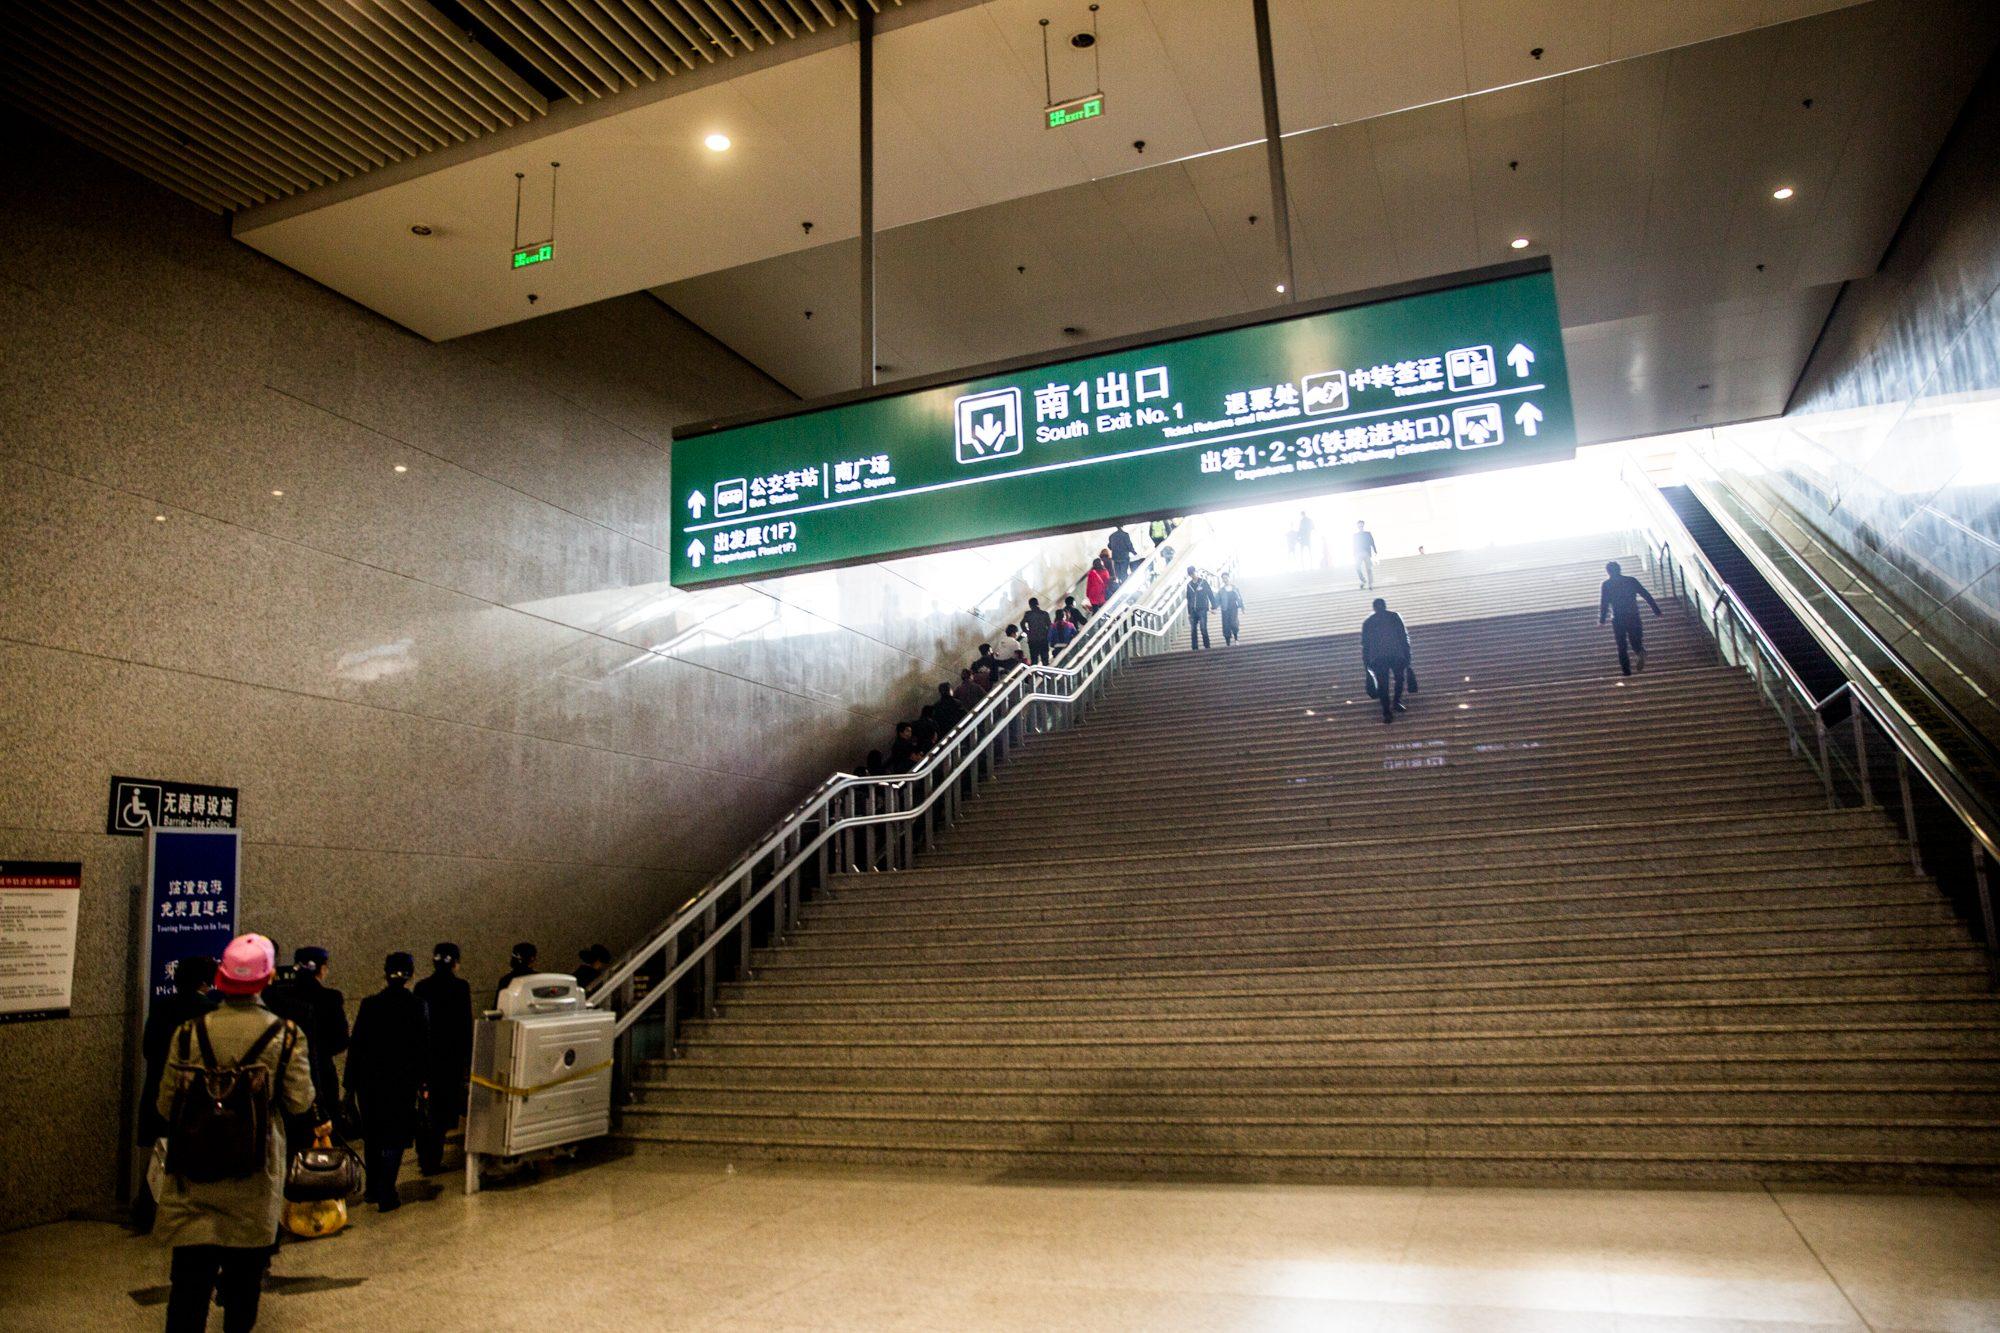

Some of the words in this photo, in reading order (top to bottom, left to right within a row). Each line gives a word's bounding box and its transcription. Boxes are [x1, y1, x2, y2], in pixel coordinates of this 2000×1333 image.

[1348, 357, 1444, 392] 中转签证
[1391, 380, 1445, 397] Transfer
[1034, 365, 1169, 422] 南1出口
[1036, 420, 1089, 443] South
[1096, 412, 1133, 433] Exit
[749, 466, 819, 497] 公交车站
[834, 454, 890, 482] 南广场
[834, 481, 862, 494] South
[863, 475, 897, 489] Square
[749, 498, 767, 509] Bus
[767, 492, 799, 505] Station
[164, 791, 233, 817] 无障碍设施
